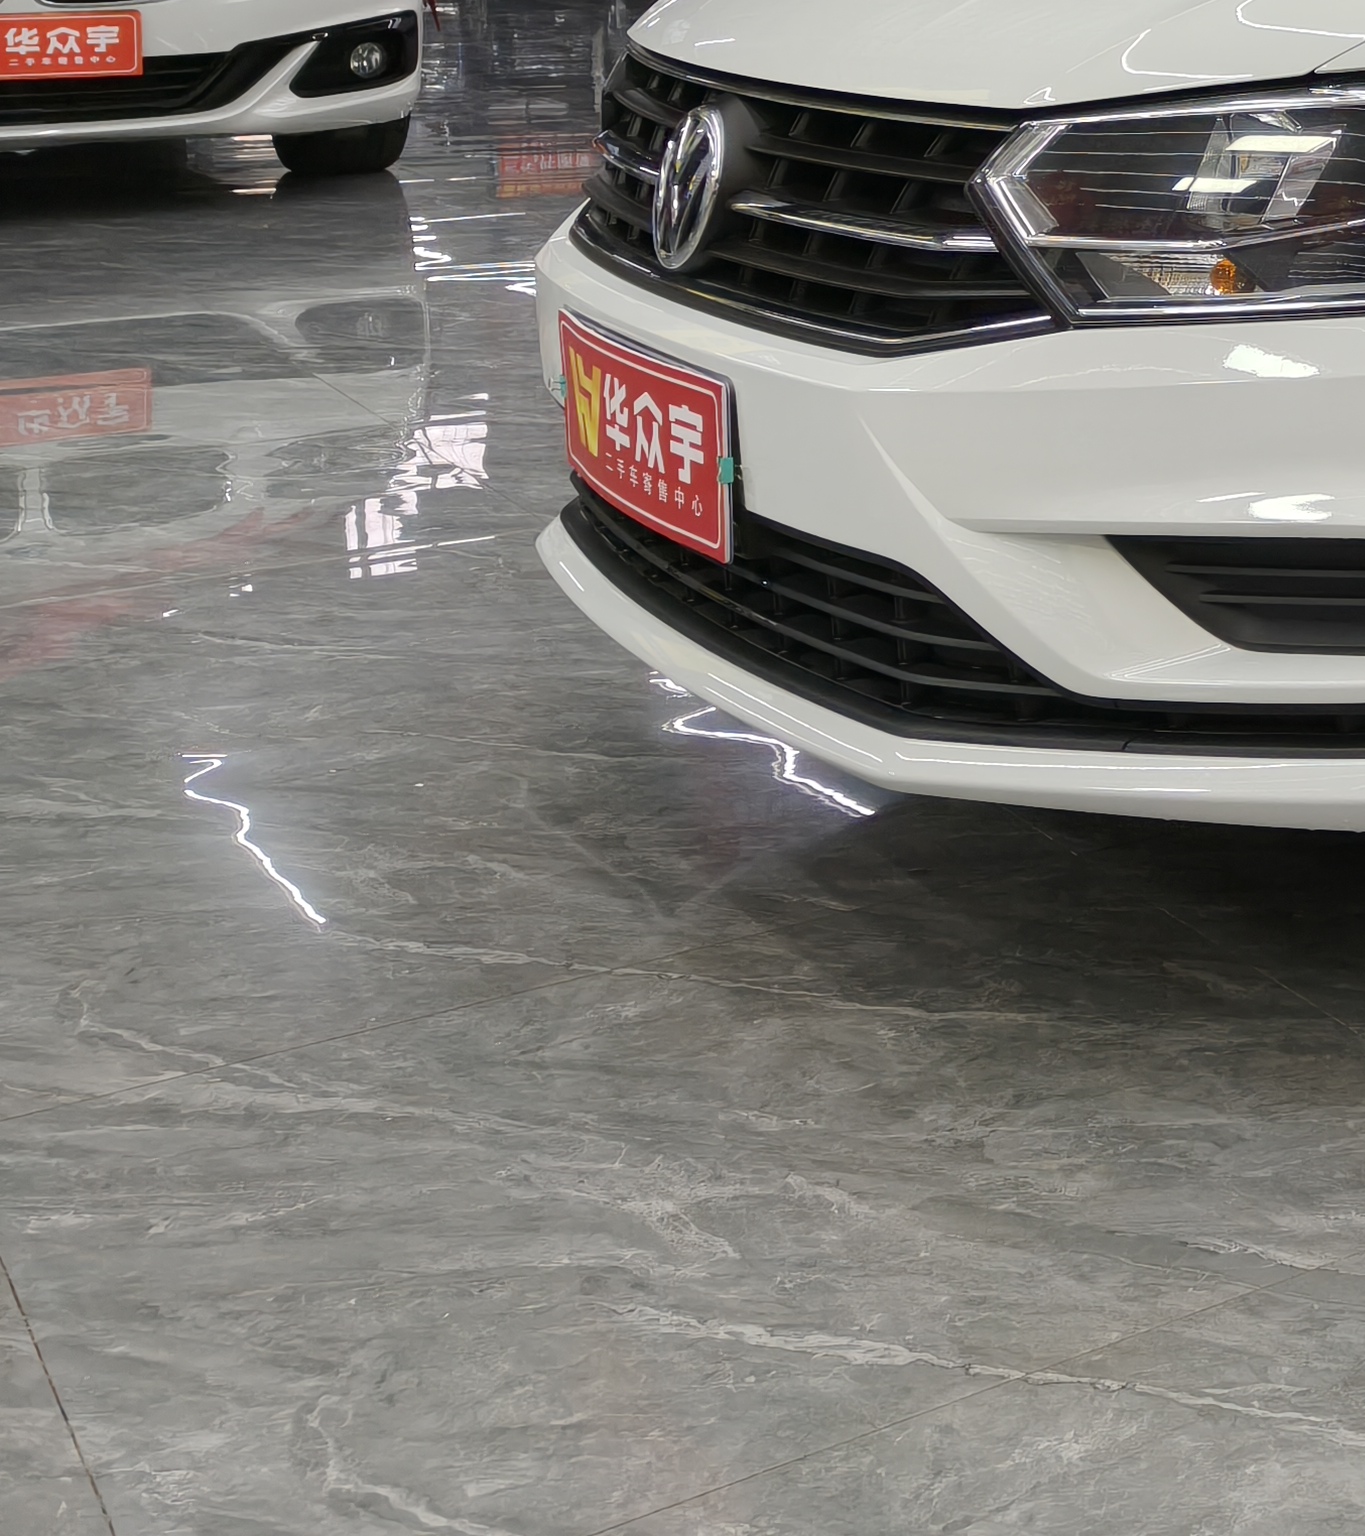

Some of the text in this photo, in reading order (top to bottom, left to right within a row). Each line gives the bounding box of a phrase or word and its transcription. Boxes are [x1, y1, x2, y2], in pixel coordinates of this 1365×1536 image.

[4, 25, 120, 55] 华众宇
[602, 373, 705, 485] 华众宇
